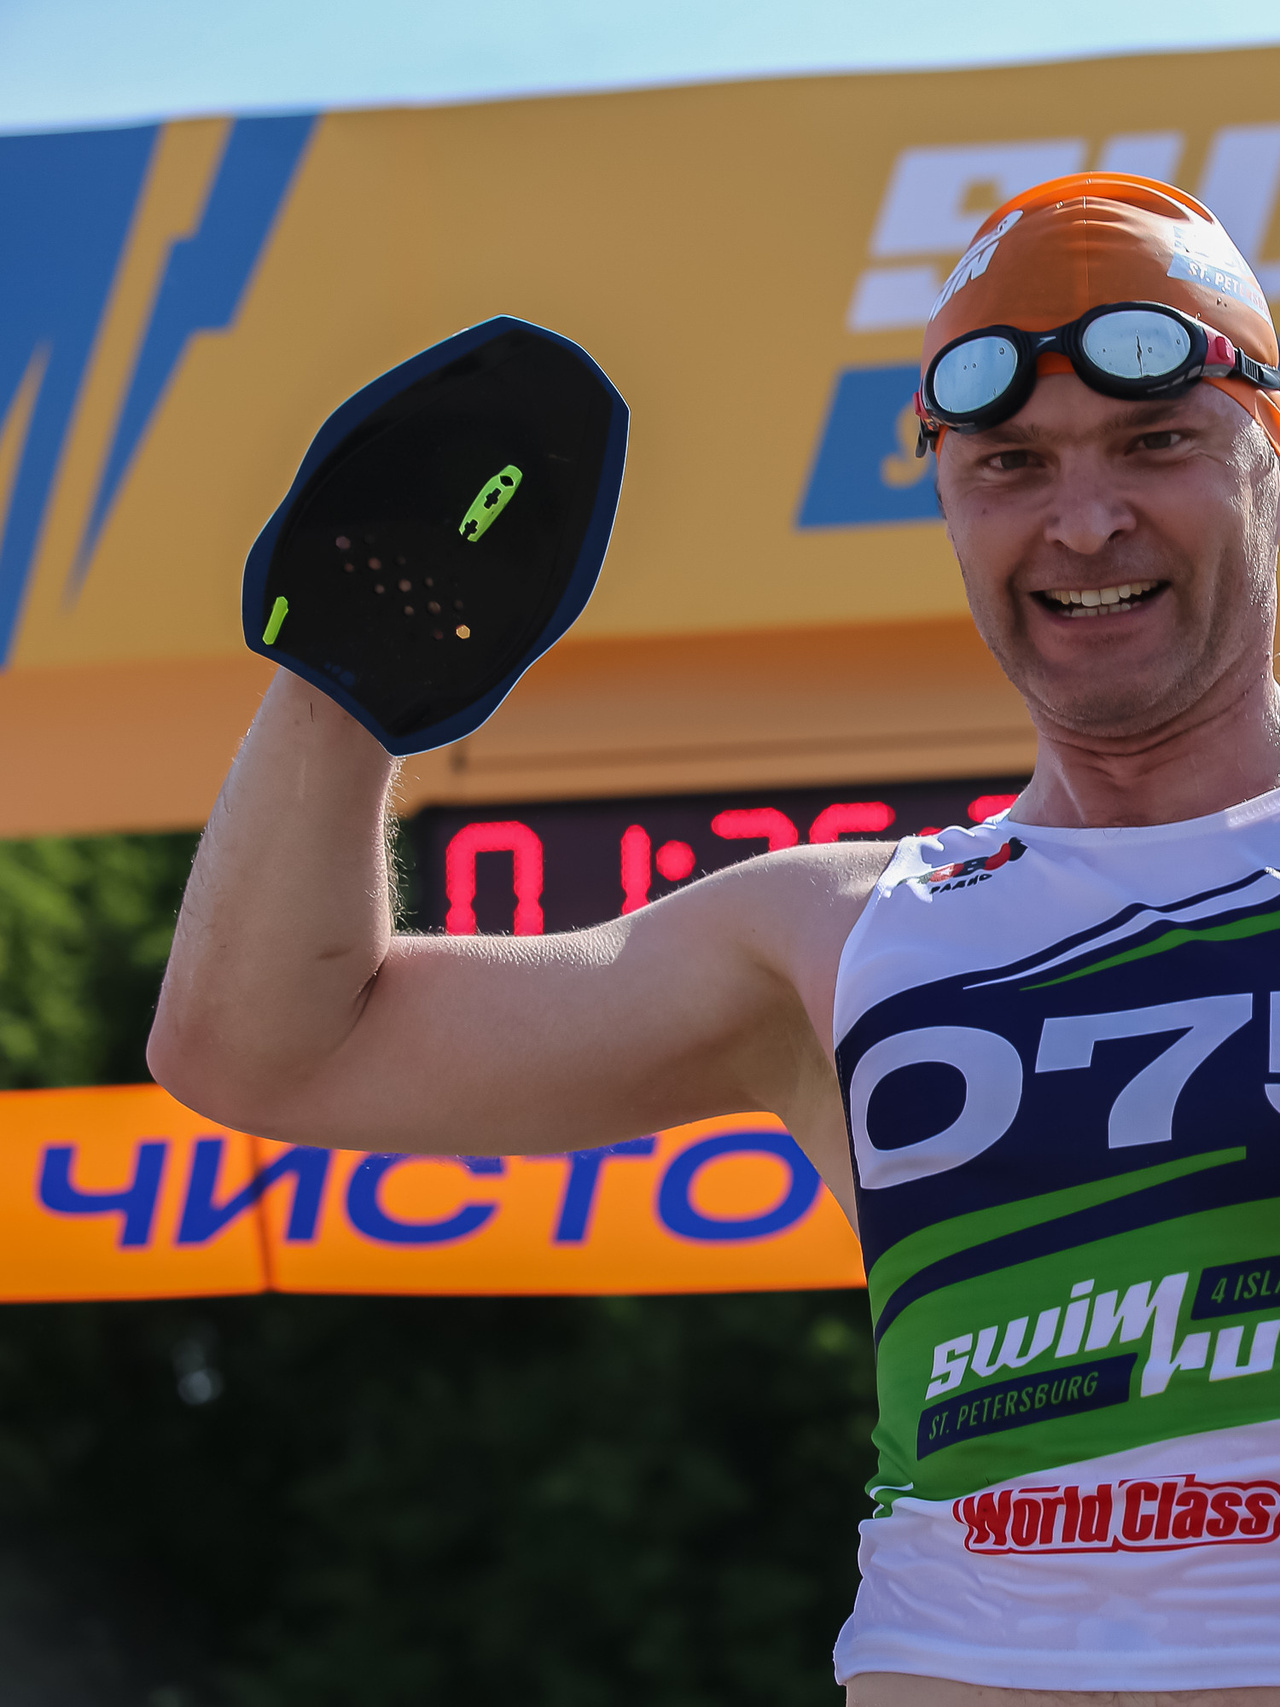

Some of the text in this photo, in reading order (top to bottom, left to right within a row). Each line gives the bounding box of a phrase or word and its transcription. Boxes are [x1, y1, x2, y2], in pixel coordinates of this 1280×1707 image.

[1211, 1277, 1226, 1304] 4
[928, 1371, 1099, 1440] ST. PETERSBURG
[962, 1480, 1277, 1547] World Class
